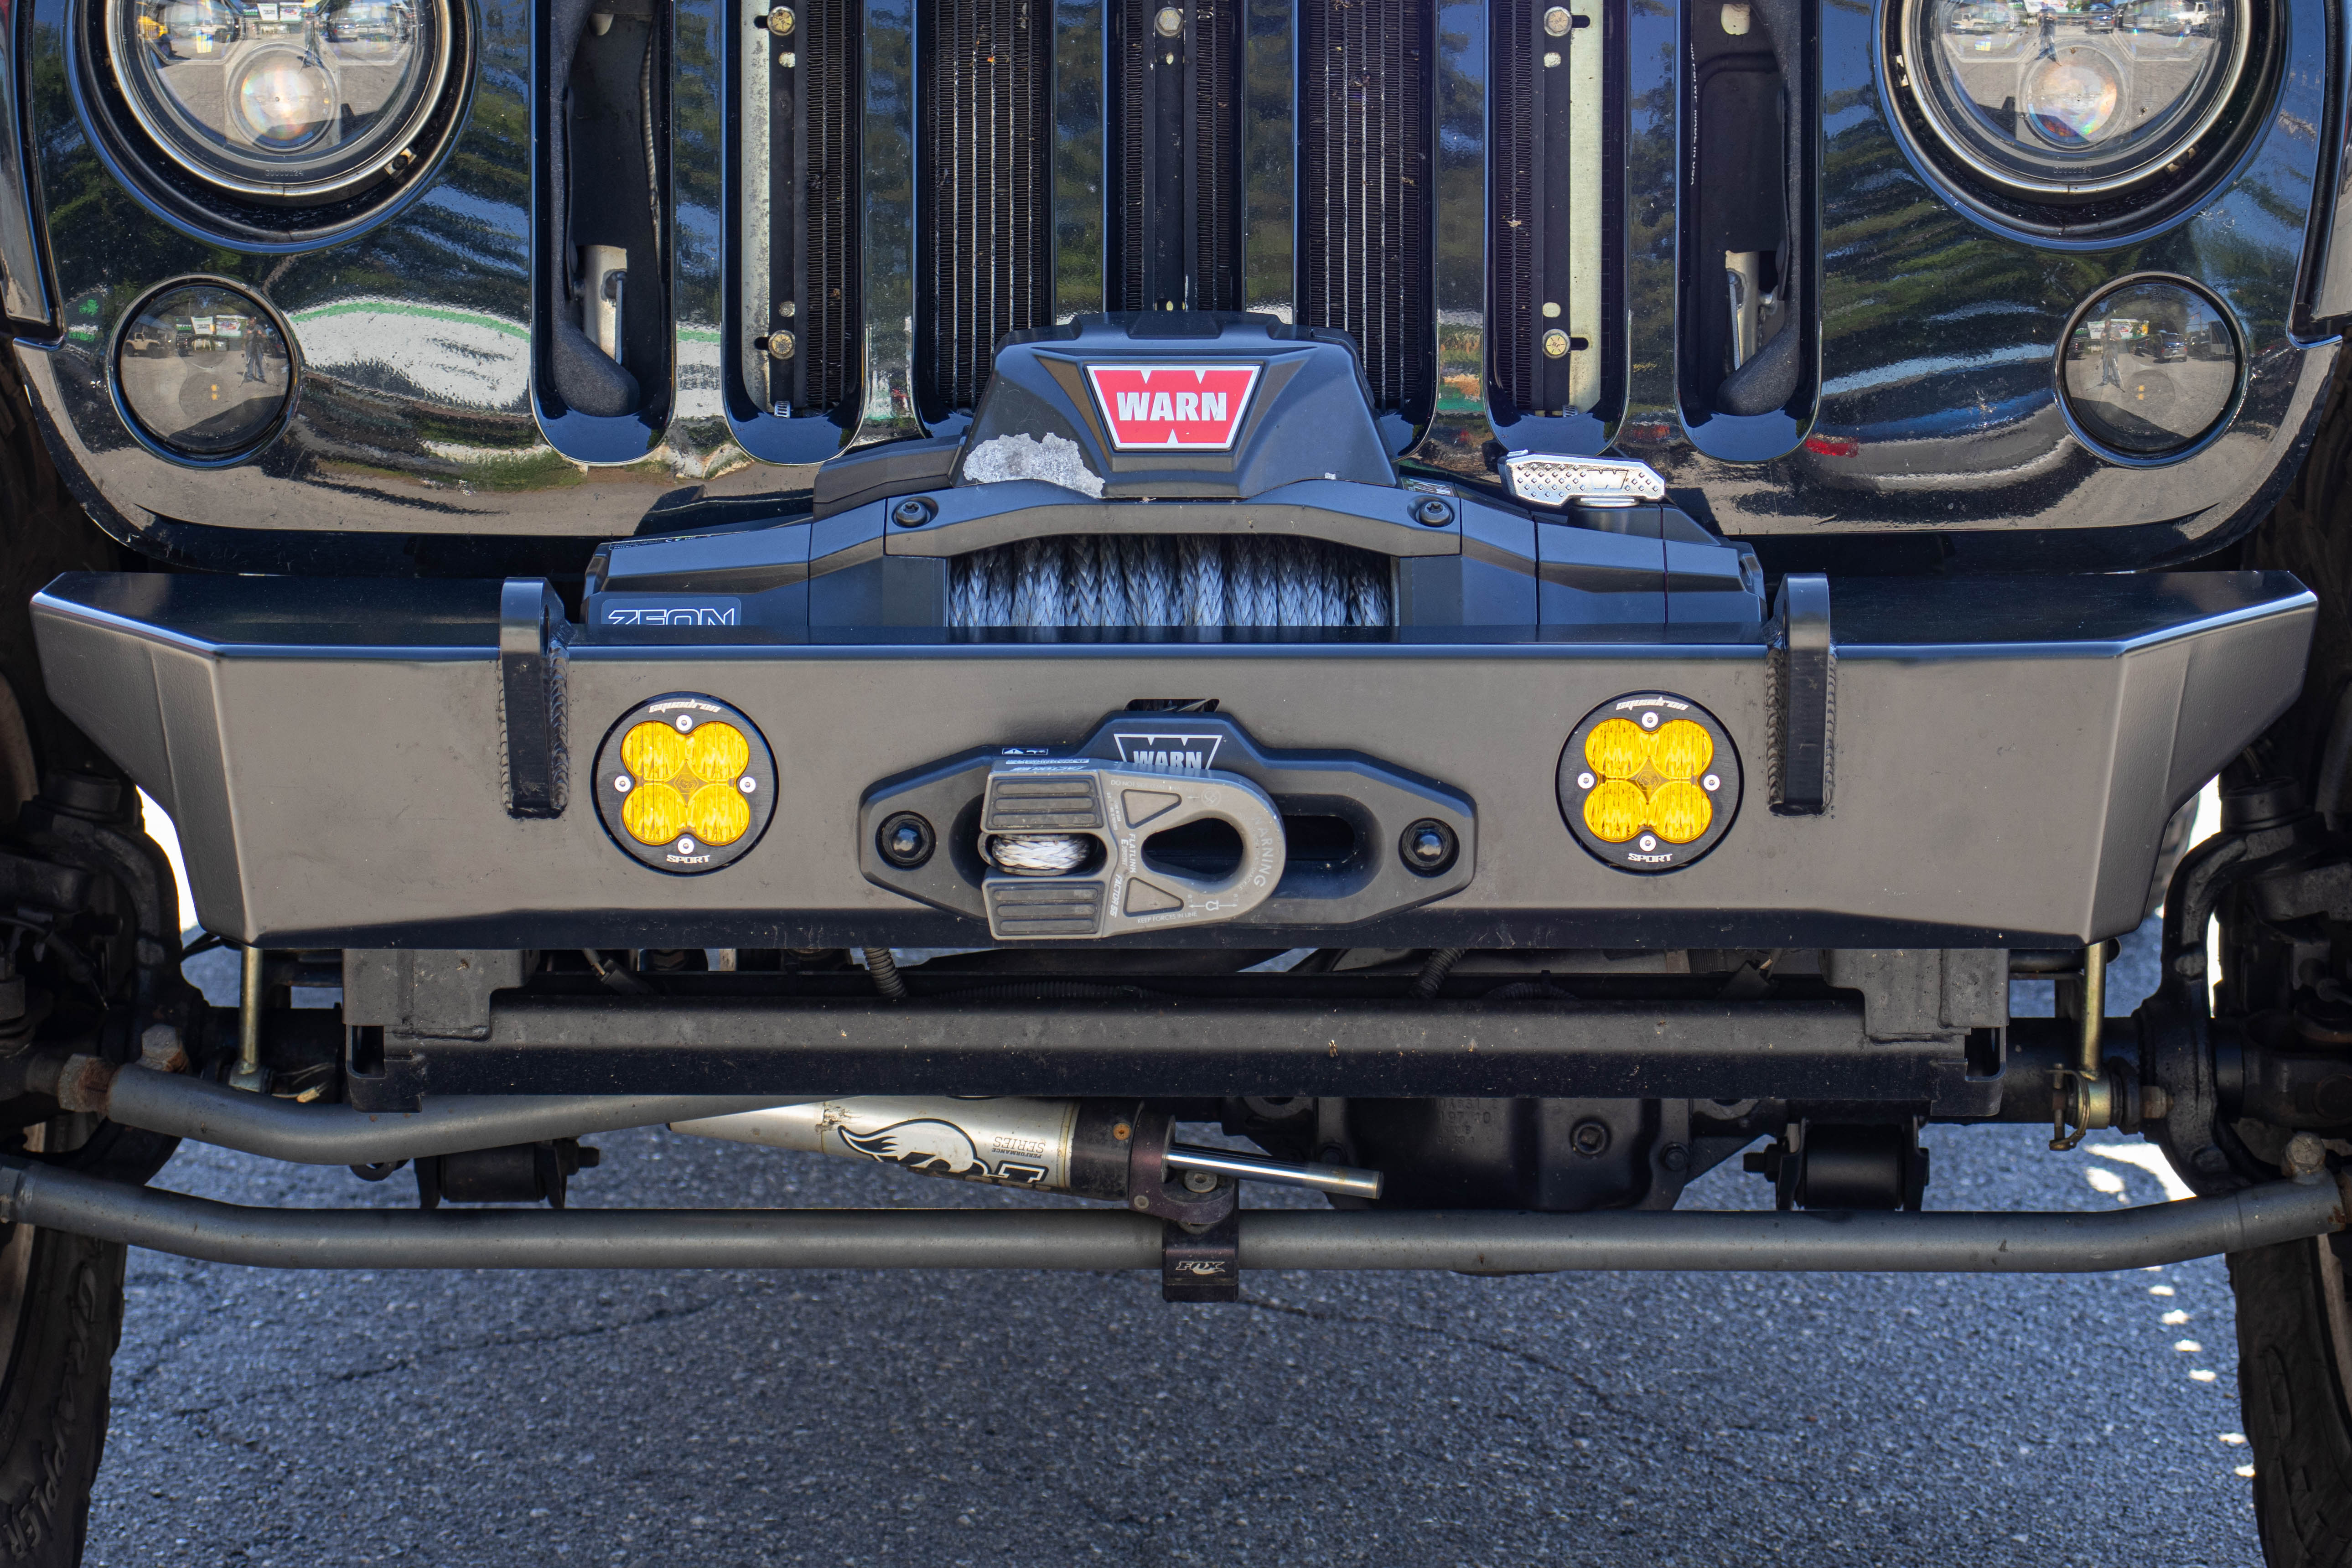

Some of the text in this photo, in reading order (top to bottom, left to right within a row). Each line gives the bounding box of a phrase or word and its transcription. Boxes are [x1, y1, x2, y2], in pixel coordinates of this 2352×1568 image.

[1116, 392, 1227, 421] WARN
[608, 608, 735, 626] ZEON
[1133, 751, 1202, 770] WARN
[666, 854, 711, 864] SPORT
[1628, 853, 1673, 863] SPORT
[1112, 874, 1123, 905] FACTOR
[1152, 914, 1176, 922] FORCES
[991, 1147, 1043, 1159] PERFORMANCE
[993, 1136, 1046, 1154] SERIES
[1175, 1261, 1226, 1275] FOX
